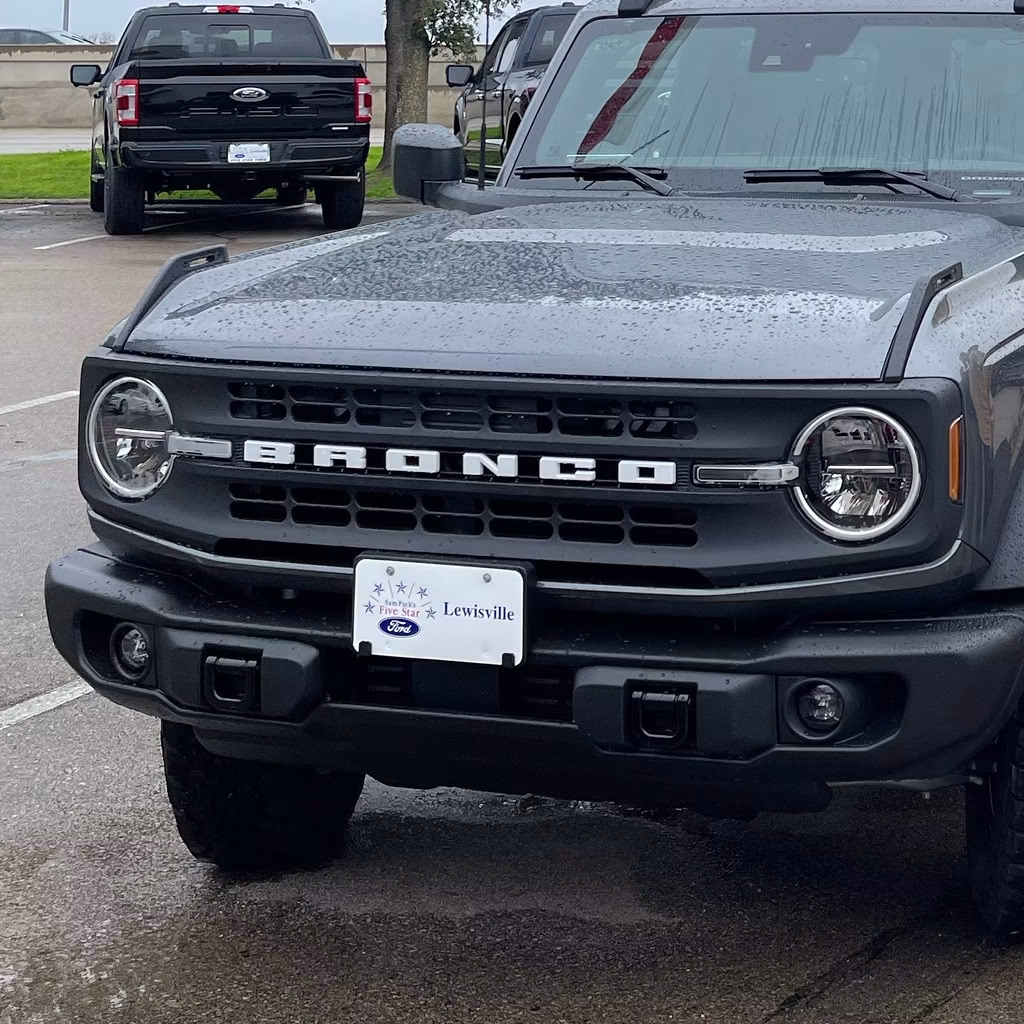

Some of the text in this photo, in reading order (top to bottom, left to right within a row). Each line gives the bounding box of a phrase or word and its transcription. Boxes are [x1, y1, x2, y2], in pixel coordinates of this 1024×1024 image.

[243, 439, 677, 485] BRONCO
[384, 599, 398, 607] Sam
[379, 605, 421, 618] Five Star
[443, 601, 515, 621] Lewisville
[387, 620, 412, 634] Ford
